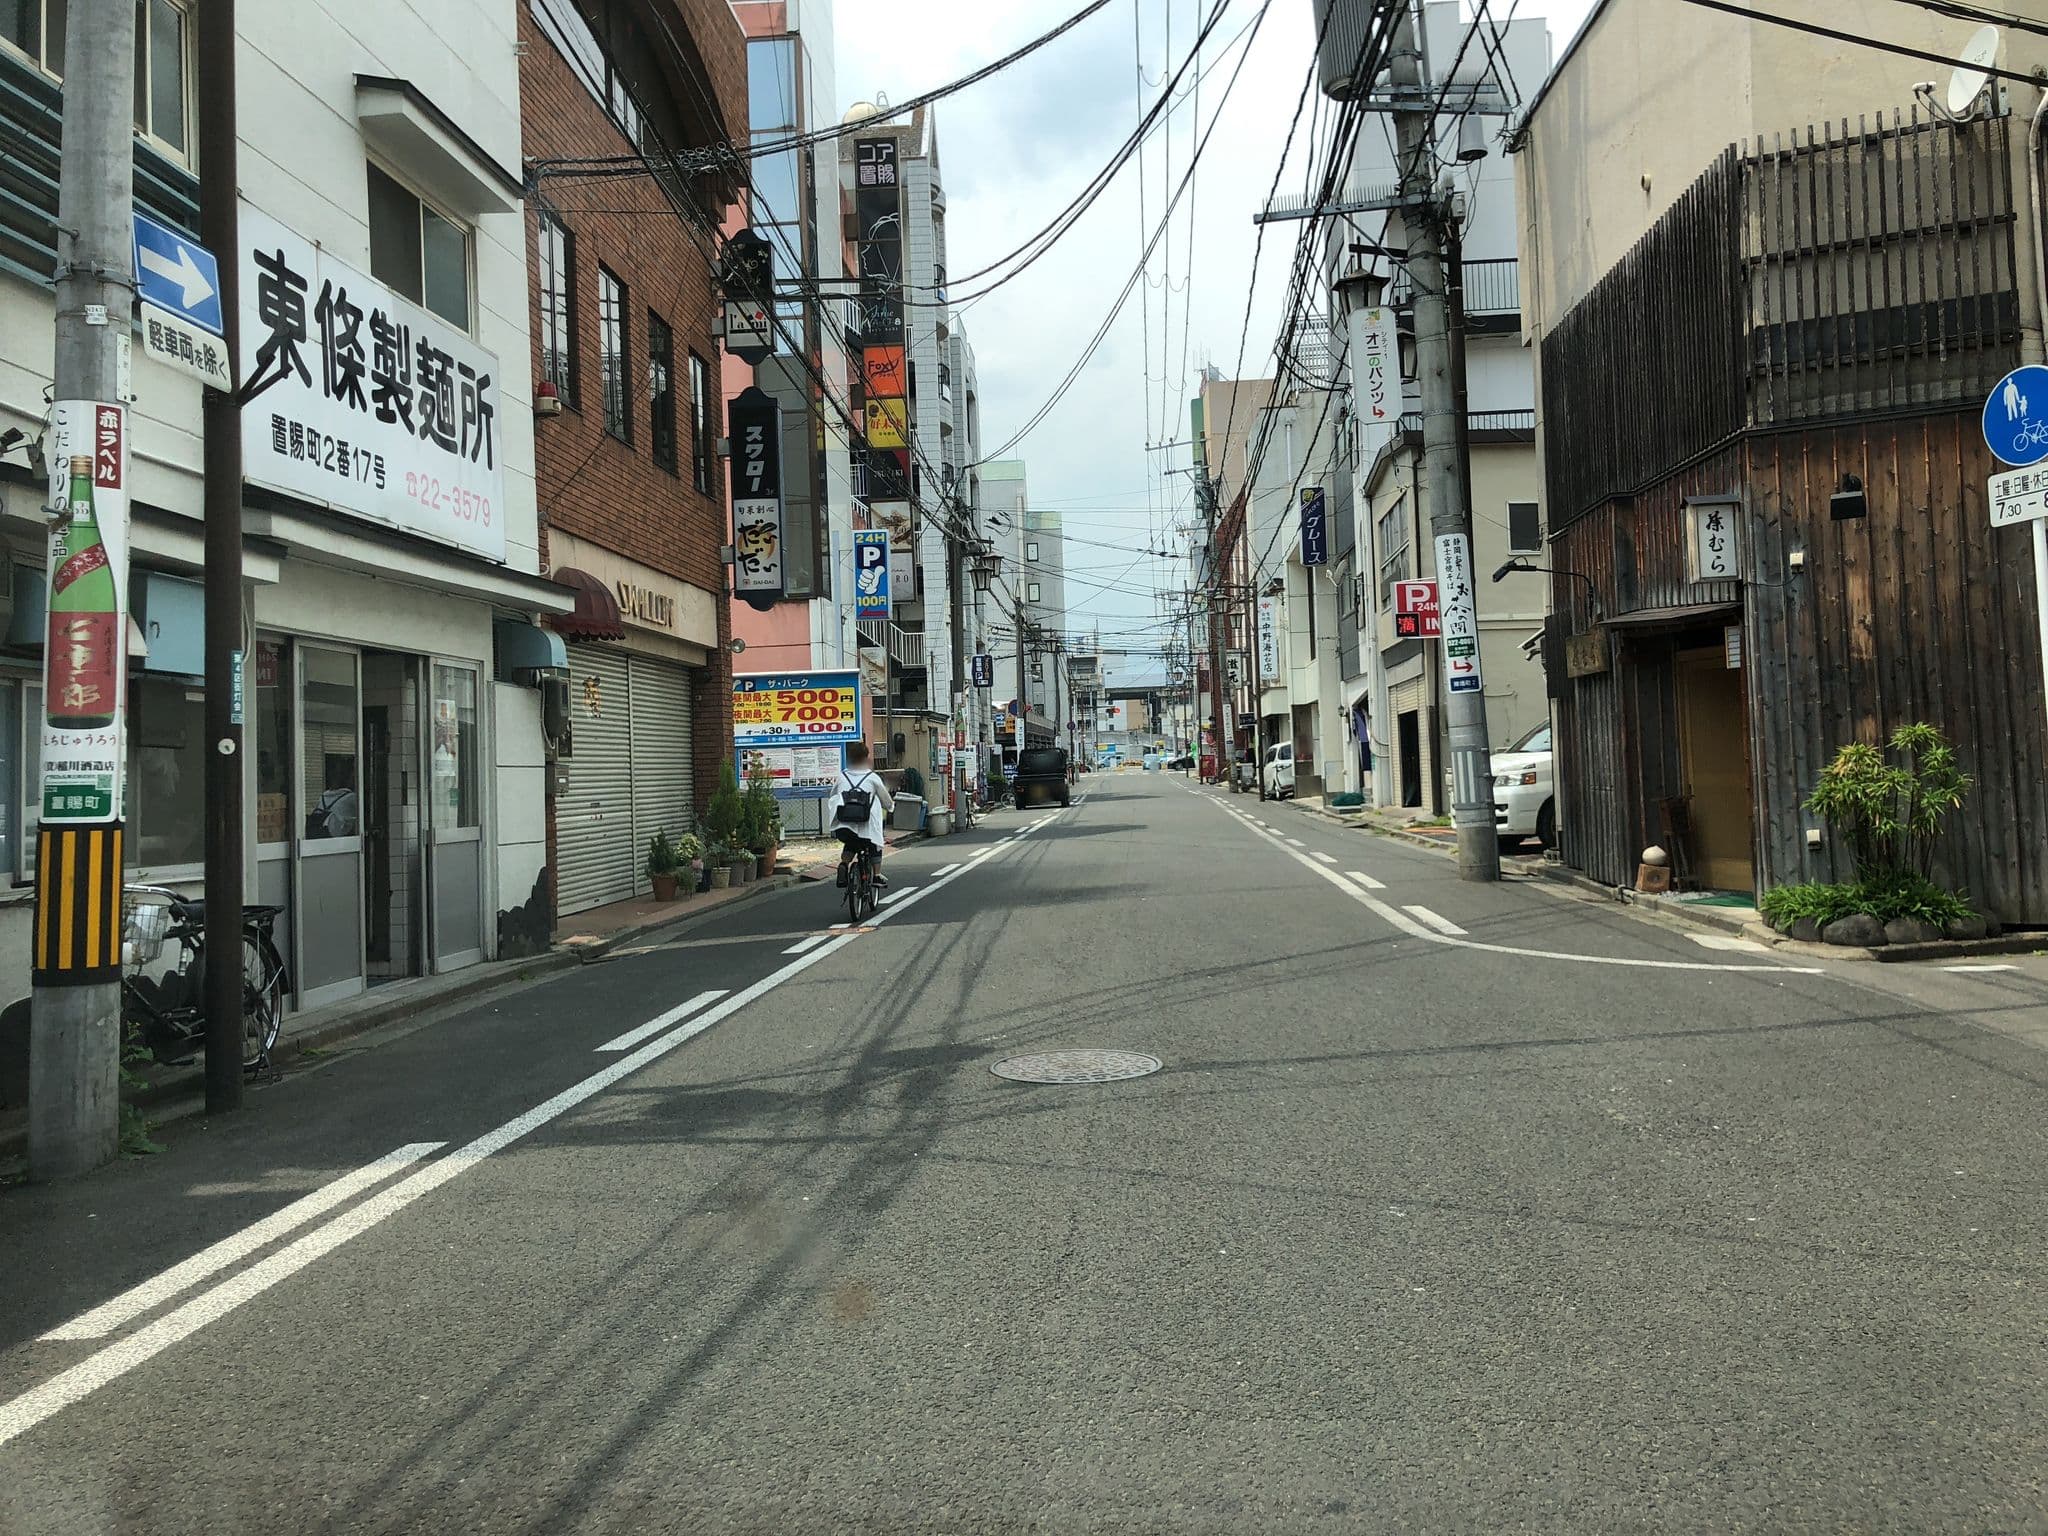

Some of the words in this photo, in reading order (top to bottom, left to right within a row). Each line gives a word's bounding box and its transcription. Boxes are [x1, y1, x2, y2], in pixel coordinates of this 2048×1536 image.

[858, 143, 894, 163] コア
[860, 164, 896, 185] 置賜
[147, 317, 228, 381] 軽車両を除く
[1365, 332, 1385, 404] オニのパンツ
[98, 410, 119, 482] 赤ラベル
[271, 412, 386, 490] 置賜町2番17号
[745, 425, 765, 492] スワロー
[420, 473, 492, 528] 22-3579
[855, 532, 886, 543] 24H
[1305, 514, 1326, 564] グレース
[863, 546, 881, 567] P
[857, 595, 887, 607] 100円
[1405, 584, 1431, 612] P
[1417, 602, 1438, 611] 24H
[1398, 616, 1415, 634] 満
[744, 681, 754, 692] P
[776, 689, 854, 705] 500円
[776, 705, 855, 722] 700円
[795, 722, 855, 734] 100円
[43, 733, 117, 746] しちじゅうろう
